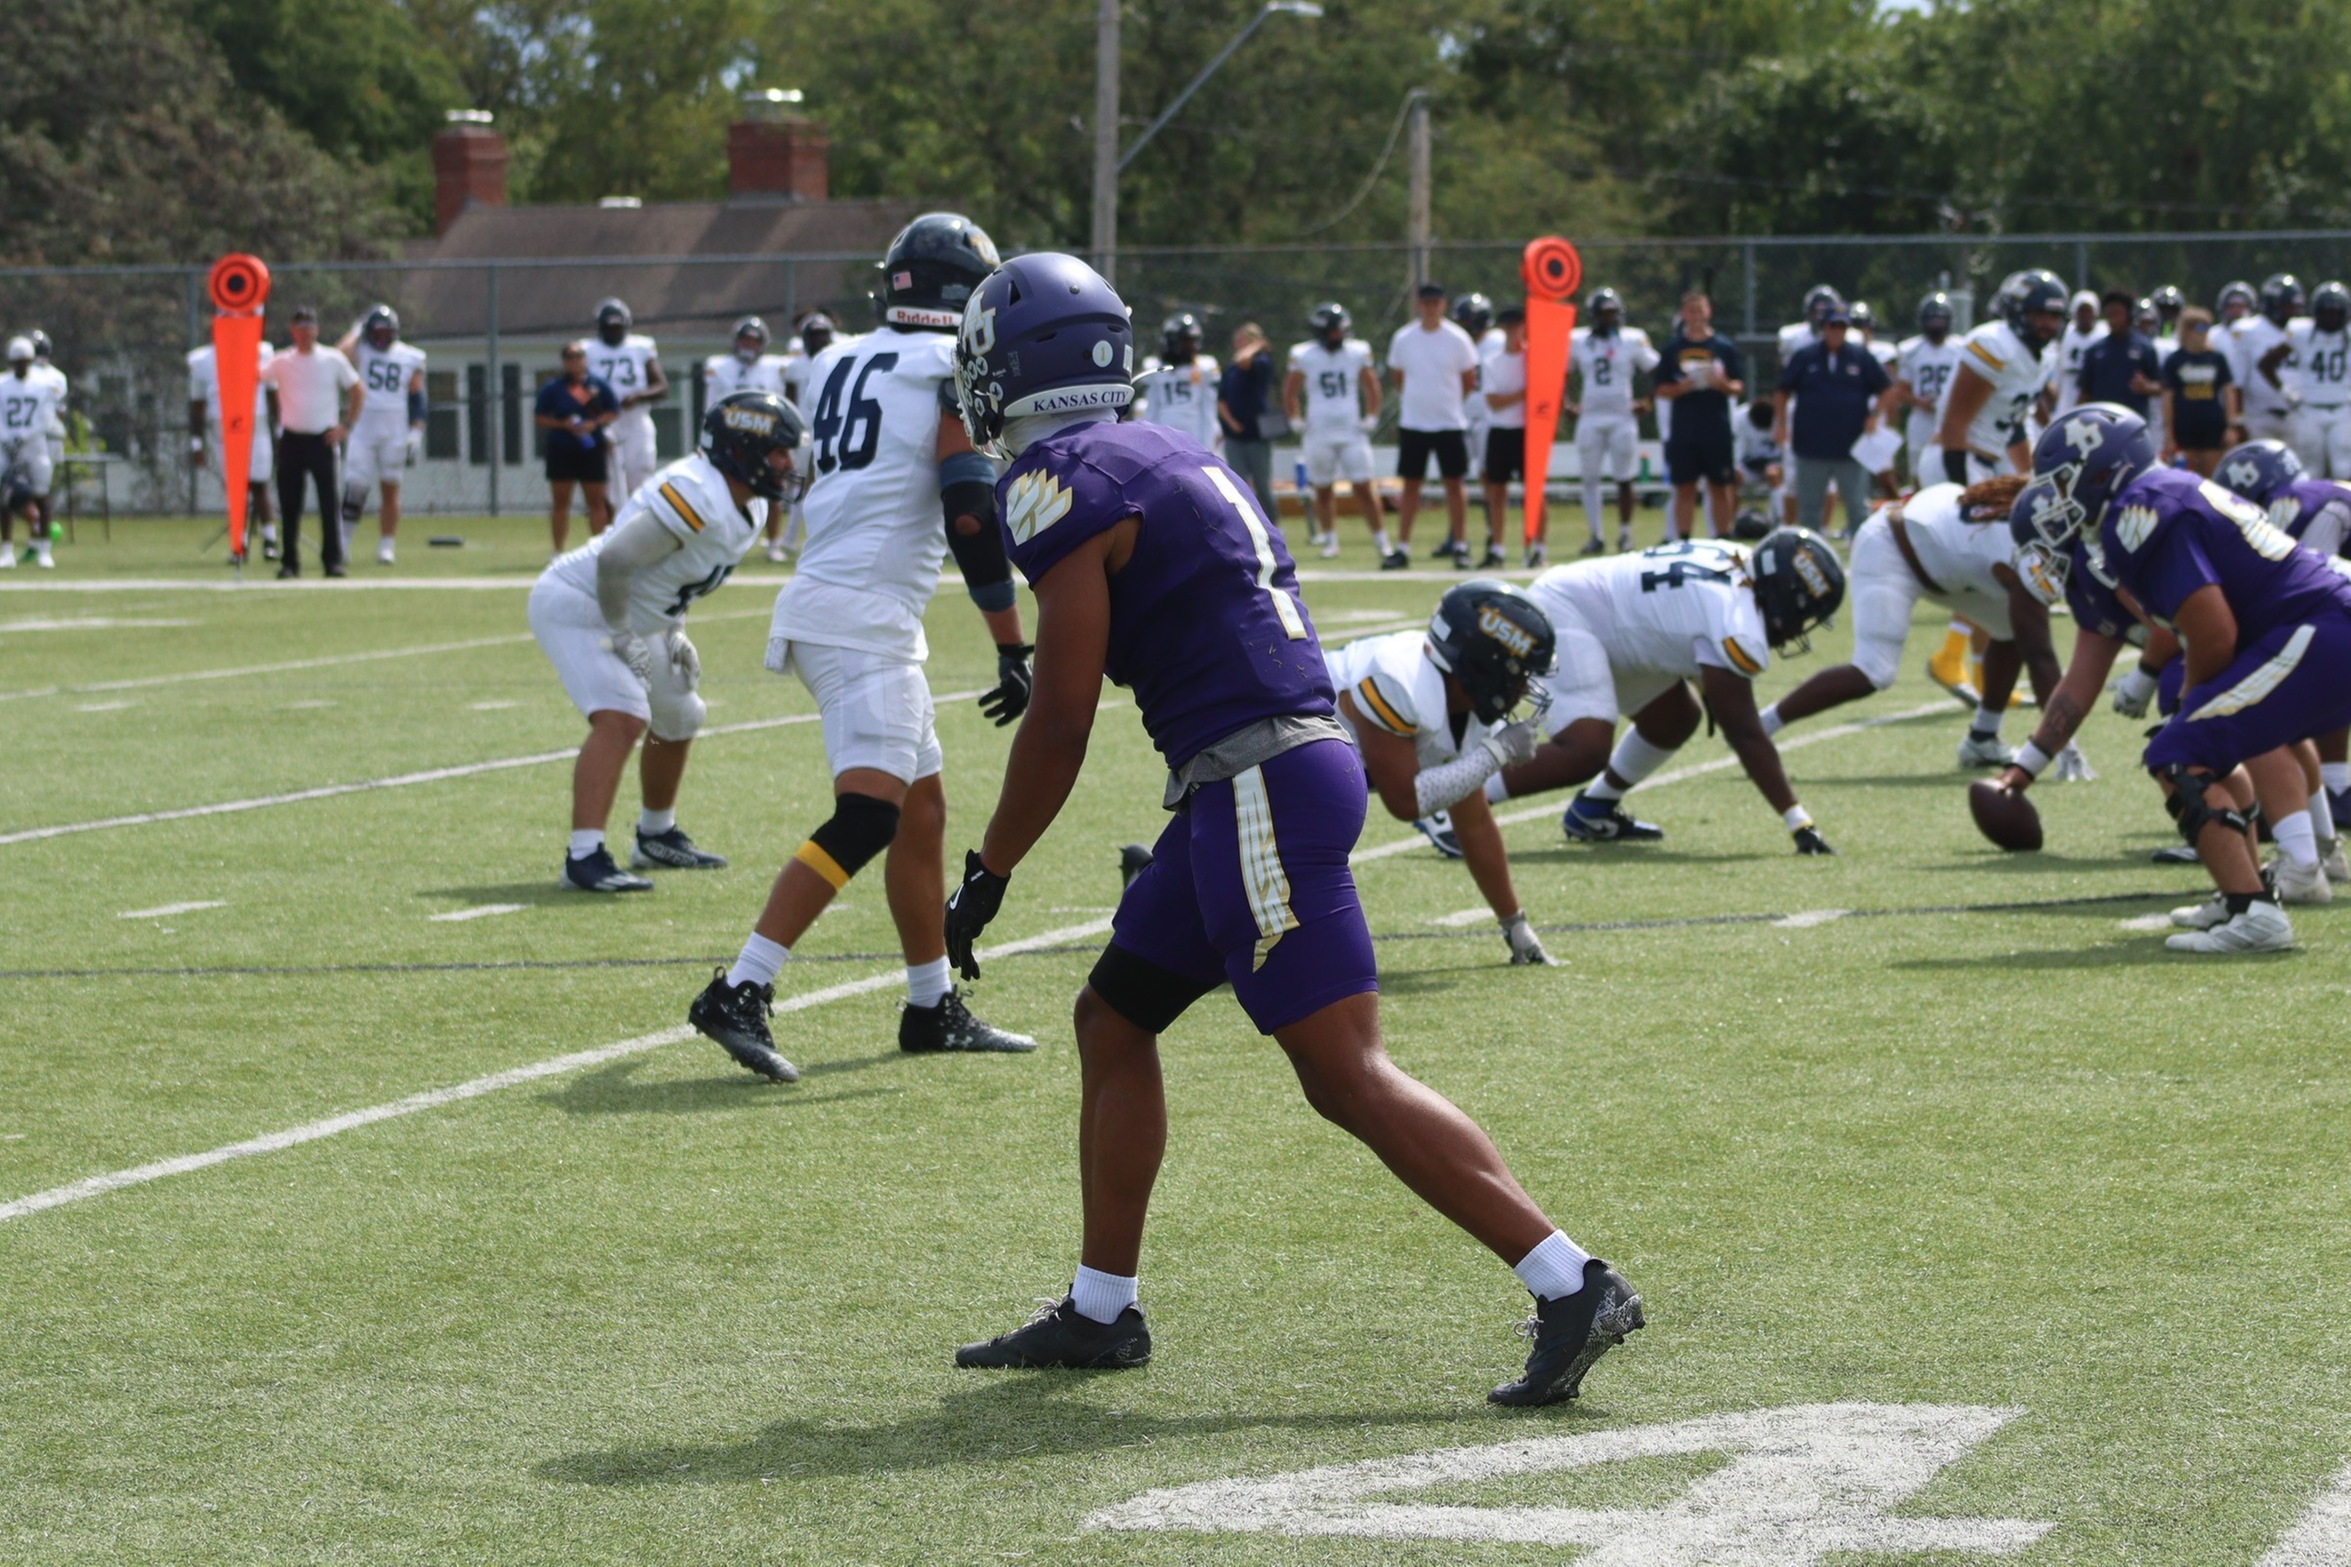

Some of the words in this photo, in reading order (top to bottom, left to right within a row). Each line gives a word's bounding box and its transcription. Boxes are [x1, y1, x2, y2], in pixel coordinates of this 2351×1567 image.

[896, 310, 954, 325] Riddell
[368, 358, 402, 392] 58
[600, 358, 637, 386] 73
[1594, 358, 1611, 385] 2
[2310, 351, 2346, 382] 40
[1165, 382, 1192, 405] 15
[1320, 371, 1346, 398] 51
[7, 397, 38, 428] 27
[814, 352, 899, 475] 46
[1034, 392, 1098, 412] KANSAS
[1101, 391, 1128, 404] CITY
[724, 406, 776, 435] USM
[1201, 466, 1308, 640] 1
[1792, 551, 1830, 599] USM
[1480, 606, 1537, 658] USM
